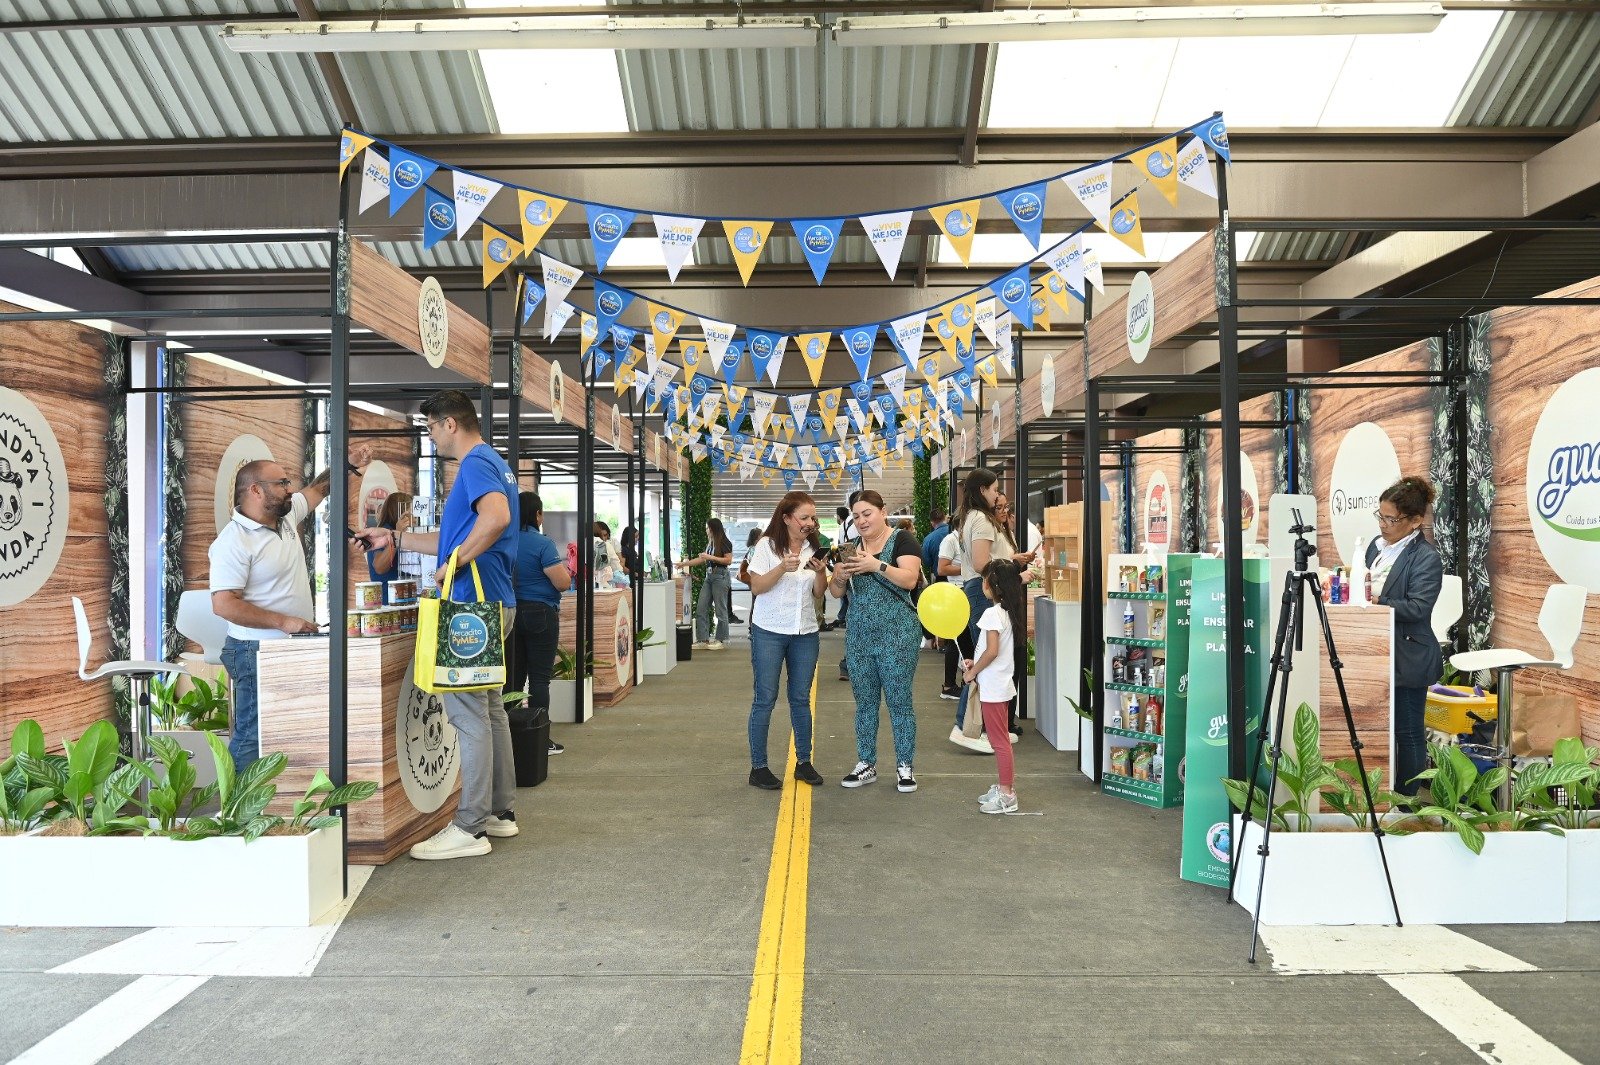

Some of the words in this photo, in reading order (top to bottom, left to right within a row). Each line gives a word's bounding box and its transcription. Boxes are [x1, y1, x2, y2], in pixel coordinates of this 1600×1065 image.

[1179, 154, 1204, 178] MEJOR
[1079, 181, 1108, 196] MEJOR
[456, 190, 486, 202] MEJOR
[662, 233, 692, 242] MEJOR
[872, 230, 902, 239] MEJOR
[1055, 250, 1080, 268] MEJOR
[547, 271, 572, 285] MEJOR
[900, 327, 921, 338] MEJOR
[1566, 514, 1585, 525] Cuida
[1586, 517, 1597, 525] tus
[452, 636, 479, 646] PyMEs
[418, 745, 450, 776] PANDA
[1198, 870, 1230, 881] BIODEGRA
